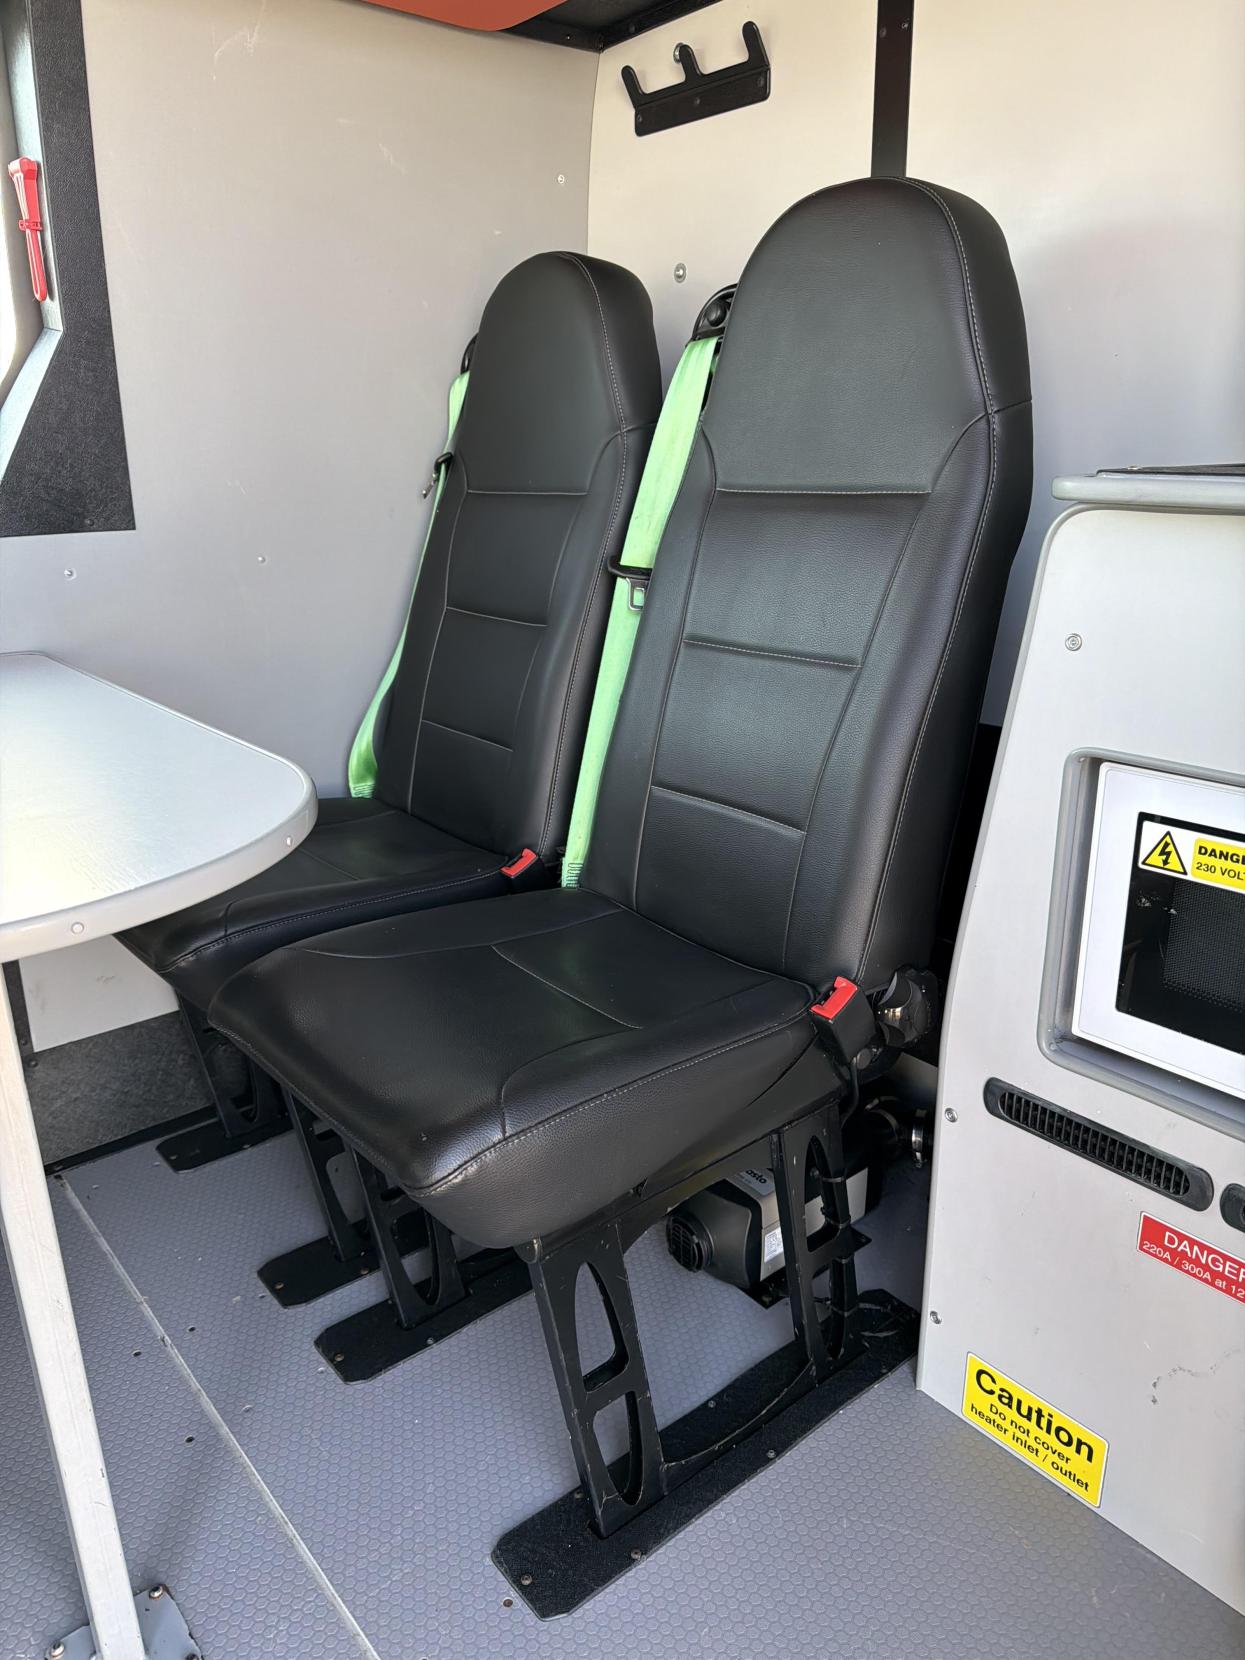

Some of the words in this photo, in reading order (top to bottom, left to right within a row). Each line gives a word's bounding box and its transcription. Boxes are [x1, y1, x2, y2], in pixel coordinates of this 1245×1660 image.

[1196, 862, 1216, 874] 230
[1220, 867, 1245, 880] VOL
[745, 1169, 767, 1184] asto
[1142, 1241, 1171, 1262] 220A
[1174, 1256, 1180, 1265] /
[1181, 1260, 1212, 1282] 300A
[1215, 1279, 1226, 1289] at
[975, 1368, 1094, 1463] Caution
[990, 1403, 1006, 1421] Do
[1010, 1419, 1031, 1437] not
[1034, 1436, 1071, 1464] cover
[970, 1403, 1009, 1435] heater
[1012, 1432, 1039, 1458] inlet
[1042, 1454, 1048, 1462] /
[1051, 1461, 1089, 1492] outlet
